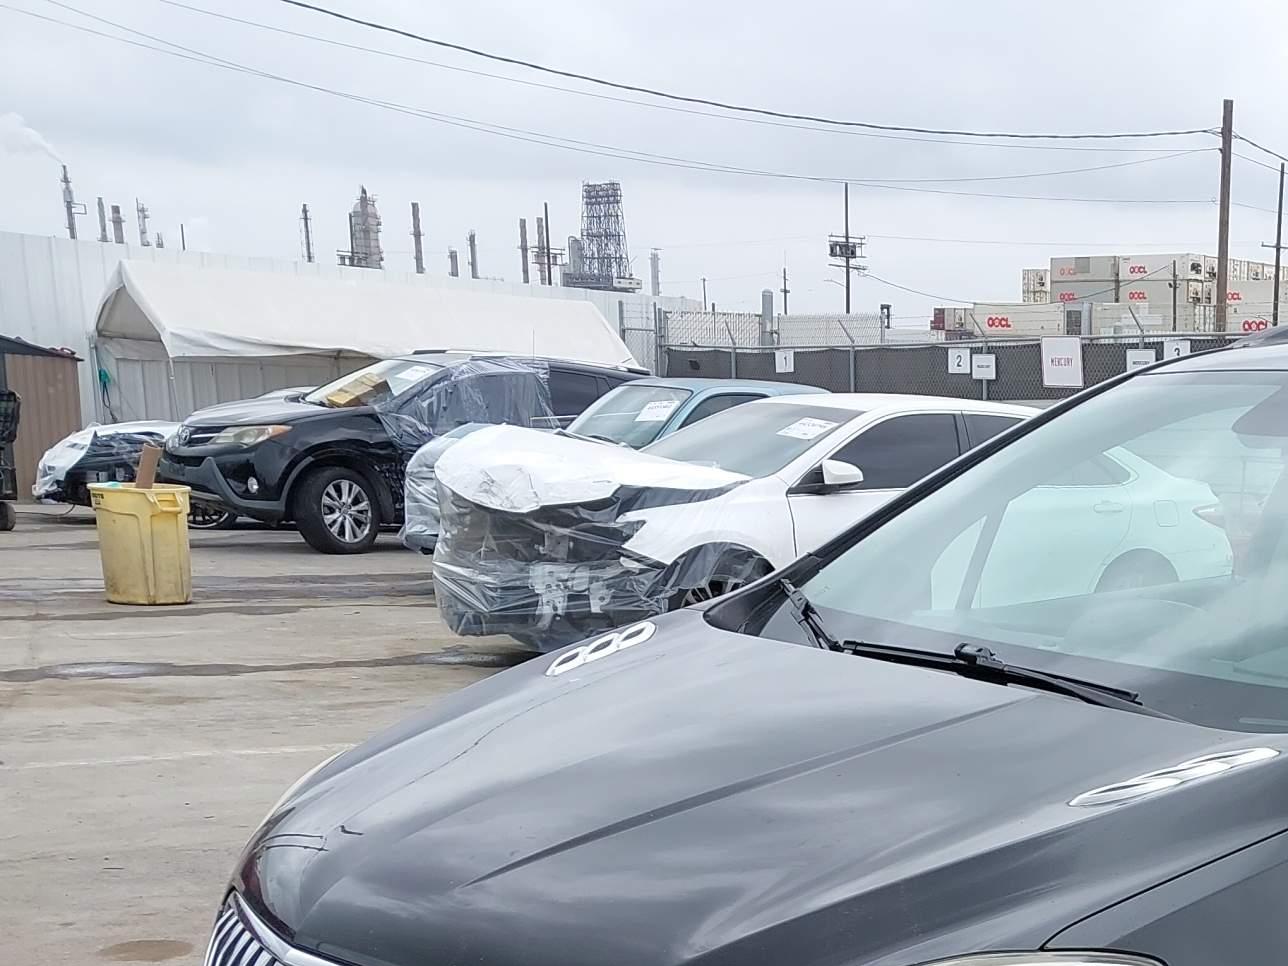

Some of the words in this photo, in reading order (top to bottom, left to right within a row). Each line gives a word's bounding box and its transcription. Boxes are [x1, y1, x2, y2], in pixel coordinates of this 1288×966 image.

[1225, 292, 1242, 301] OCL
[986, 316, 1012, 329] OOCL
[956, 354, 963, 368] 2
